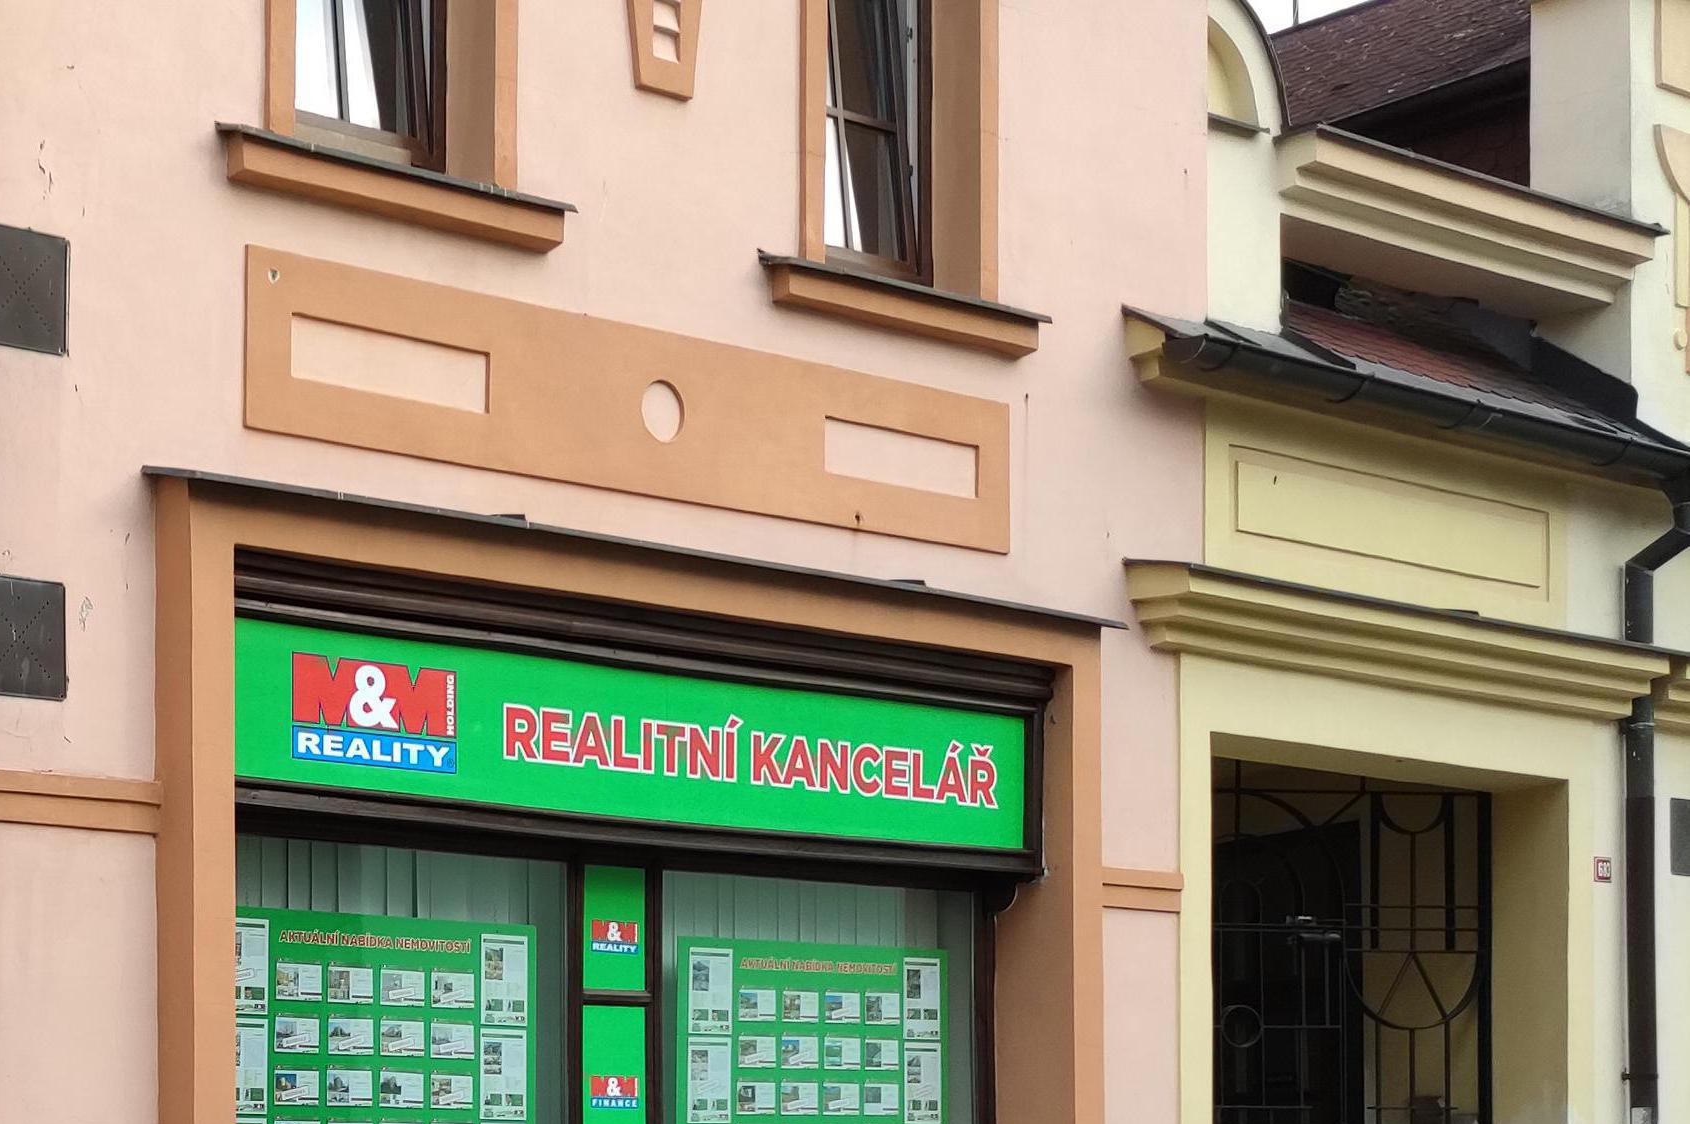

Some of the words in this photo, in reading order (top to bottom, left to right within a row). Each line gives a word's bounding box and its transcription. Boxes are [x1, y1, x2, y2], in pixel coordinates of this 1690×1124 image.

[291, 651, 457, 739] M&M
[446, 674, 455, 737] HOLDING
[297, 731, 450, 768] REALITY
[503, 703, 744, 782] REALITNÍ
[750, 731, 999, 810] KANCELÁŘ
[279, 929, 340, 946] AKTUÁLNÍ
[341, 932, 394, 949] NABÍDKA
[395, 937, 471, 953] NEMOVITOSTÍ
[592, 942, 638, 953] REALITY
[591, 1098, 638, 1108] FINANCE
